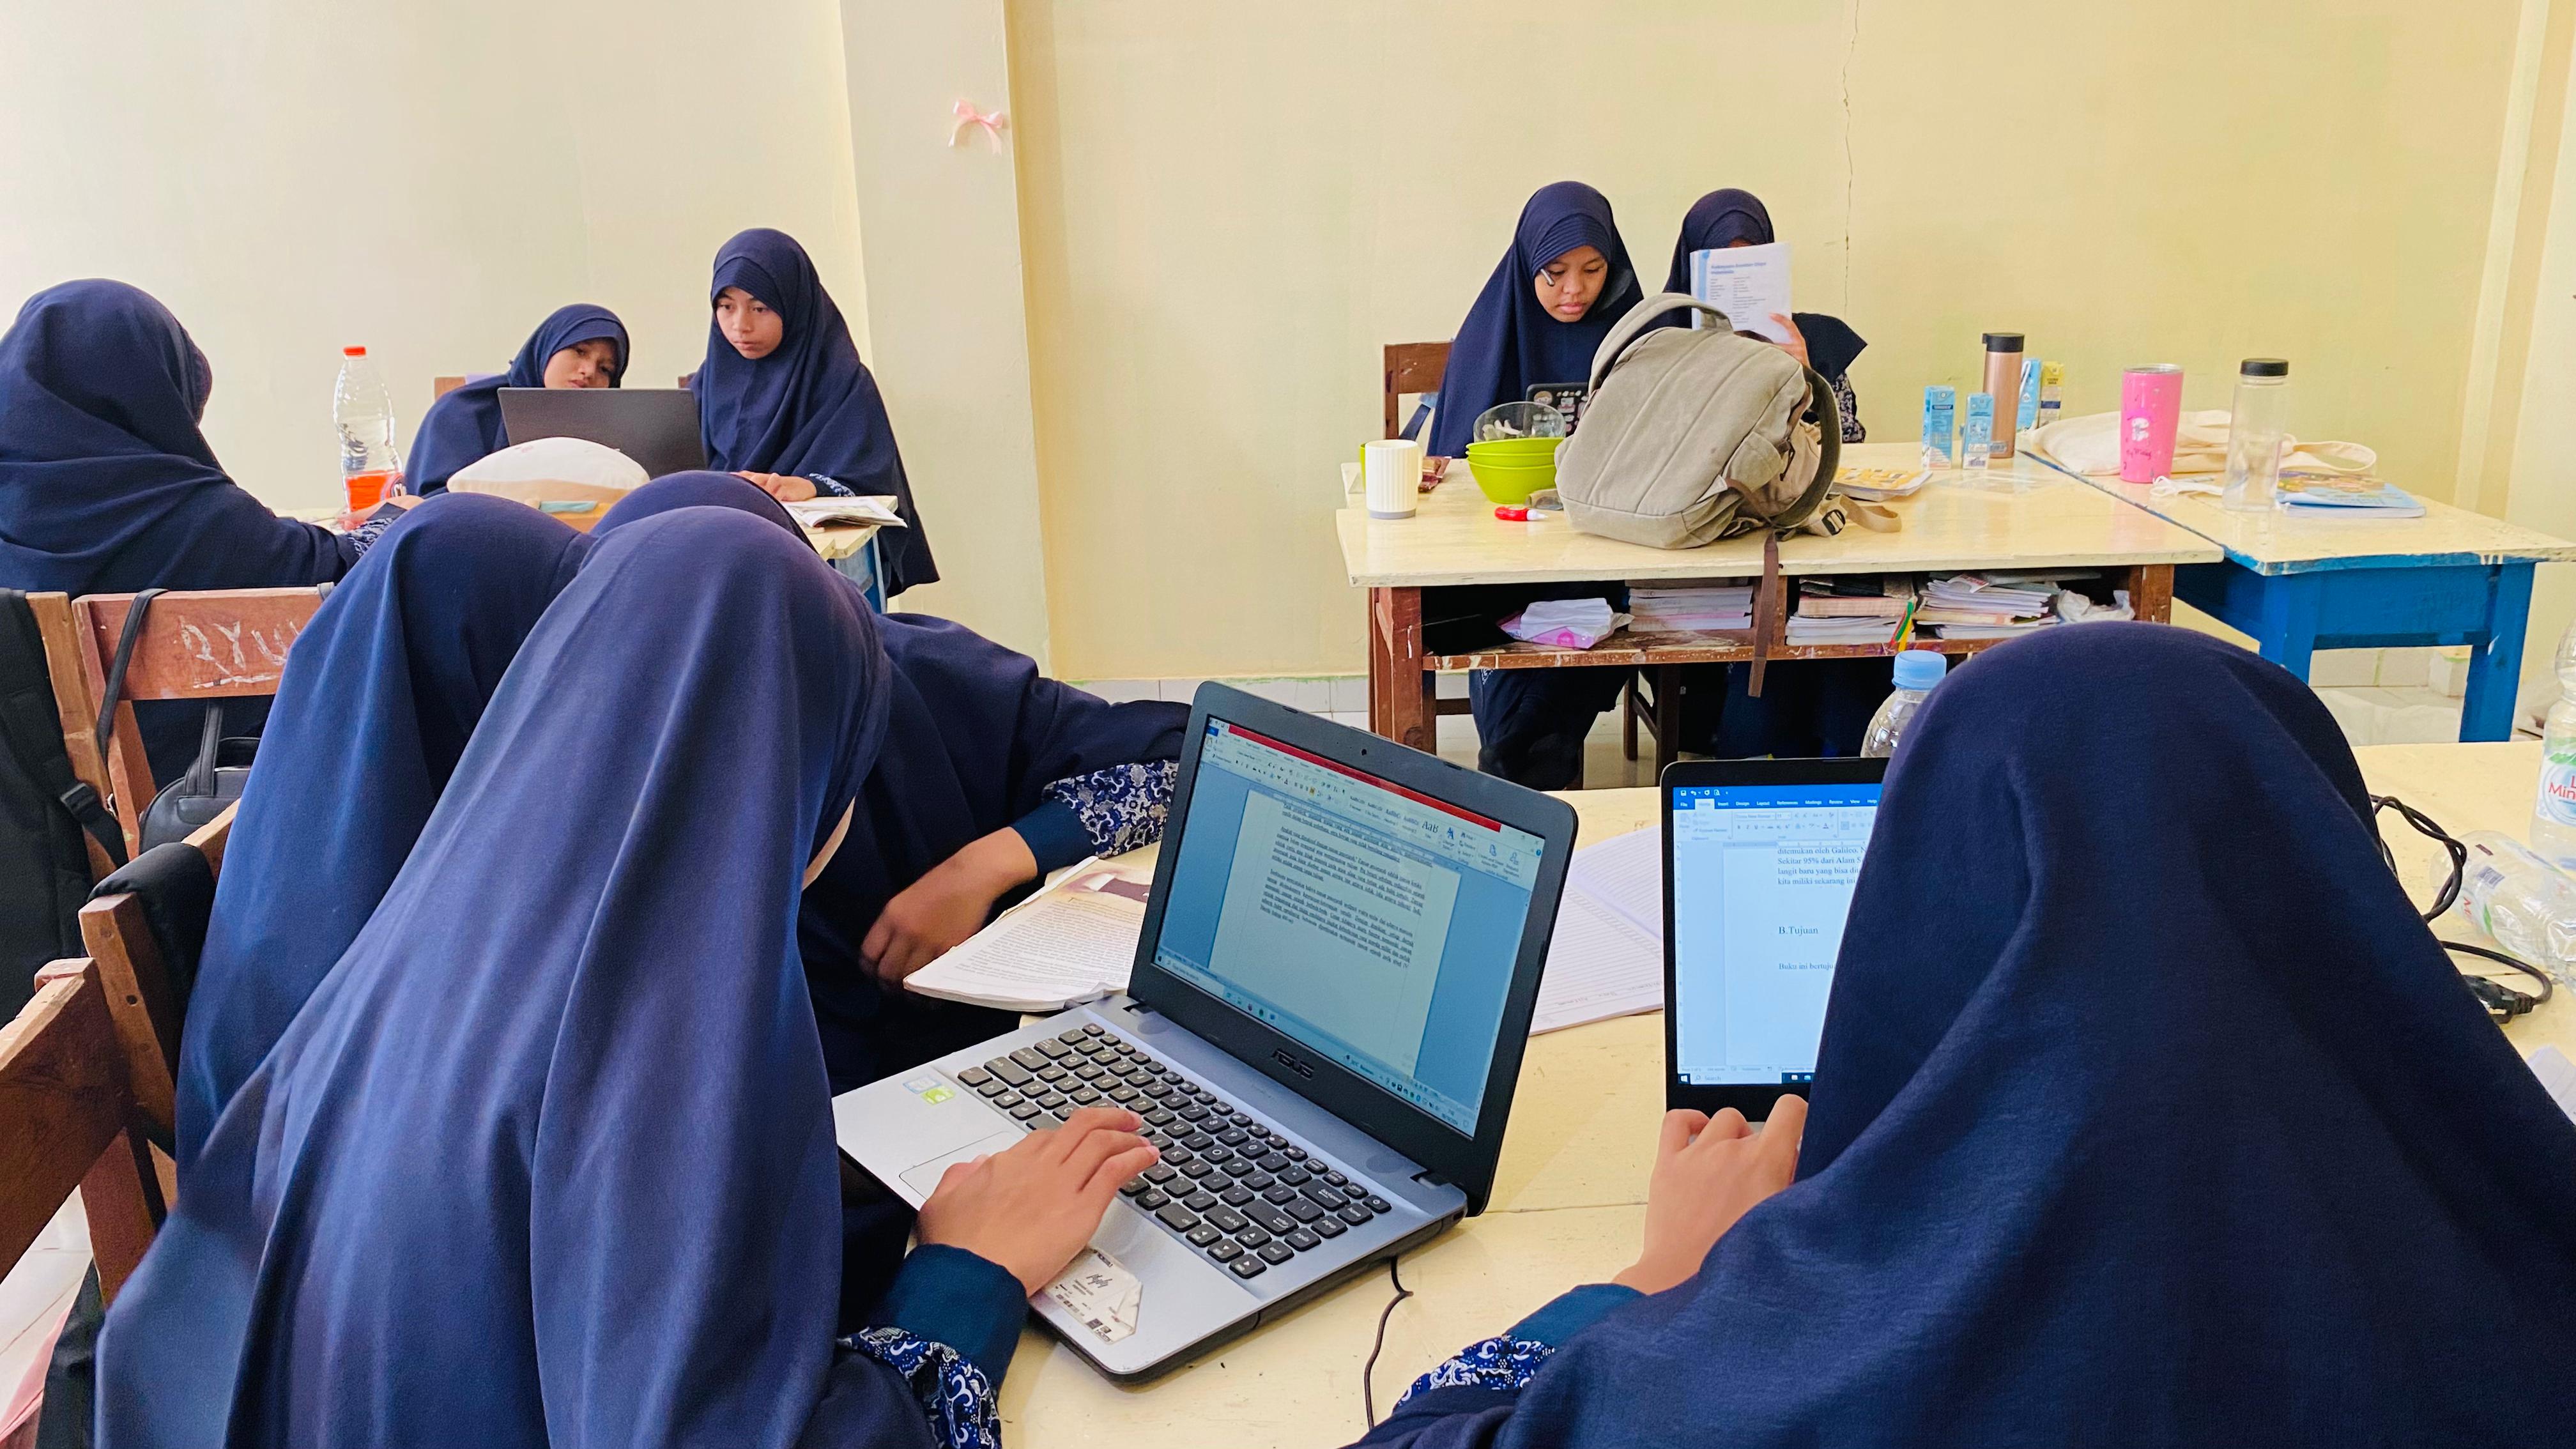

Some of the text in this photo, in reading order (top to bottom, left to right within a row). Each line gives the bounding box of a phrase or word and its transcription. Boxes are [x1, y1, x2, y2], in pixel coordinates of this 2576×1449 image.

[1778, 868, 1797, 876] langit
[1788, 926, 1818, 937] Tujuan
[1271, 1048, 1314, 1080] ASUS
